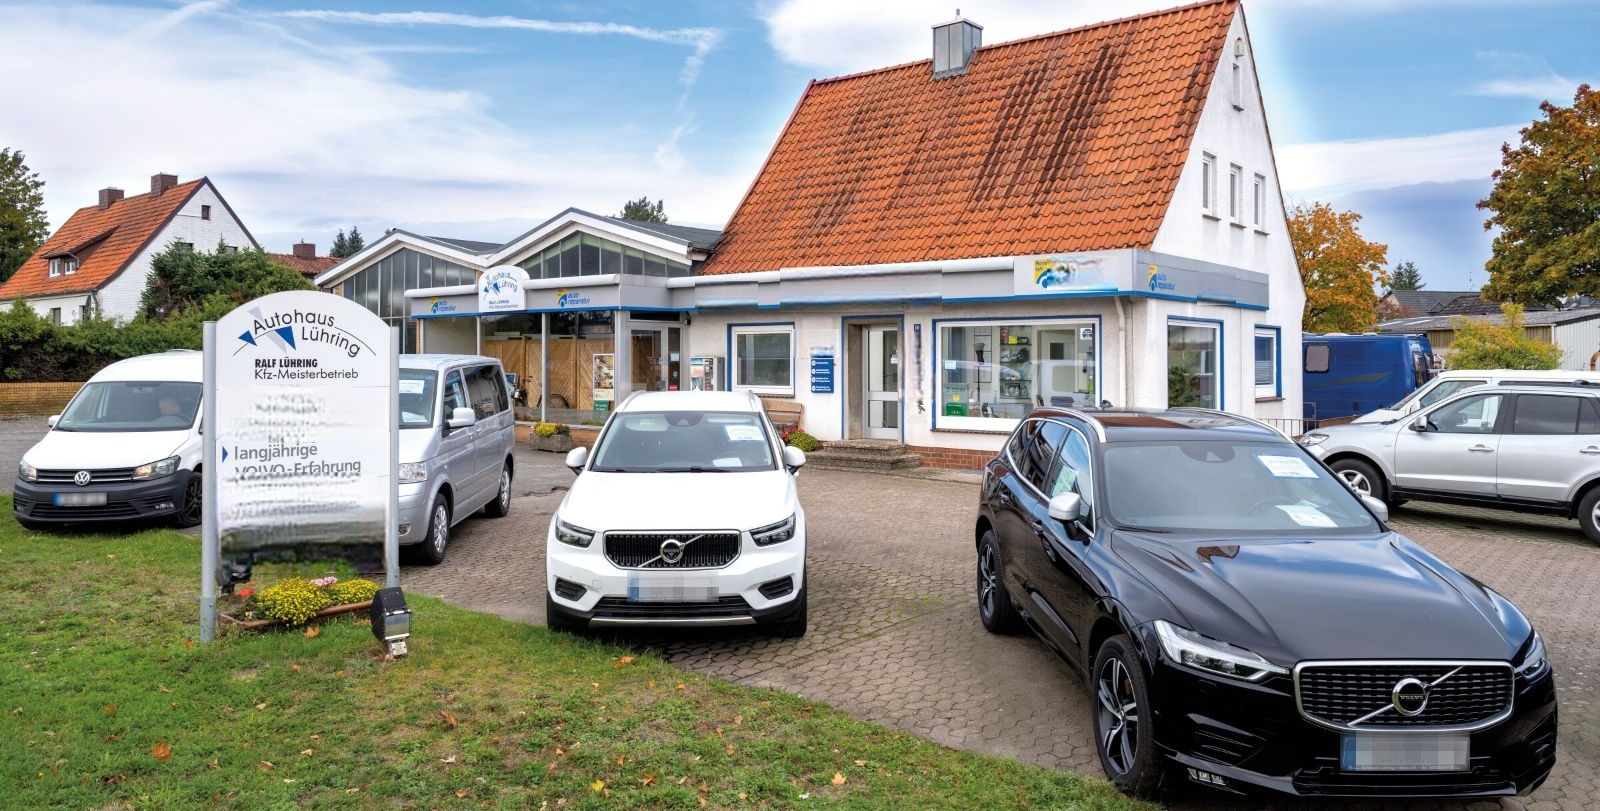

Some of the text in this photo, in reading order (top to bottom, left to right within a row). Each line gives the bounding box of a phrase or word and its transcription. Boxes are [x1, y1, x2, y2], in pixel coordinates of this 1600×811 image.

[253, 309, 335, 335] Autohaus
[301, 326, 361, 358] Lühring
[255, 356, 318, 368] RALF LÜHRING
[254, 367, 359, 380] Kfz-Meisterbetrieb
[234, 443, 318, 462] langjährige
